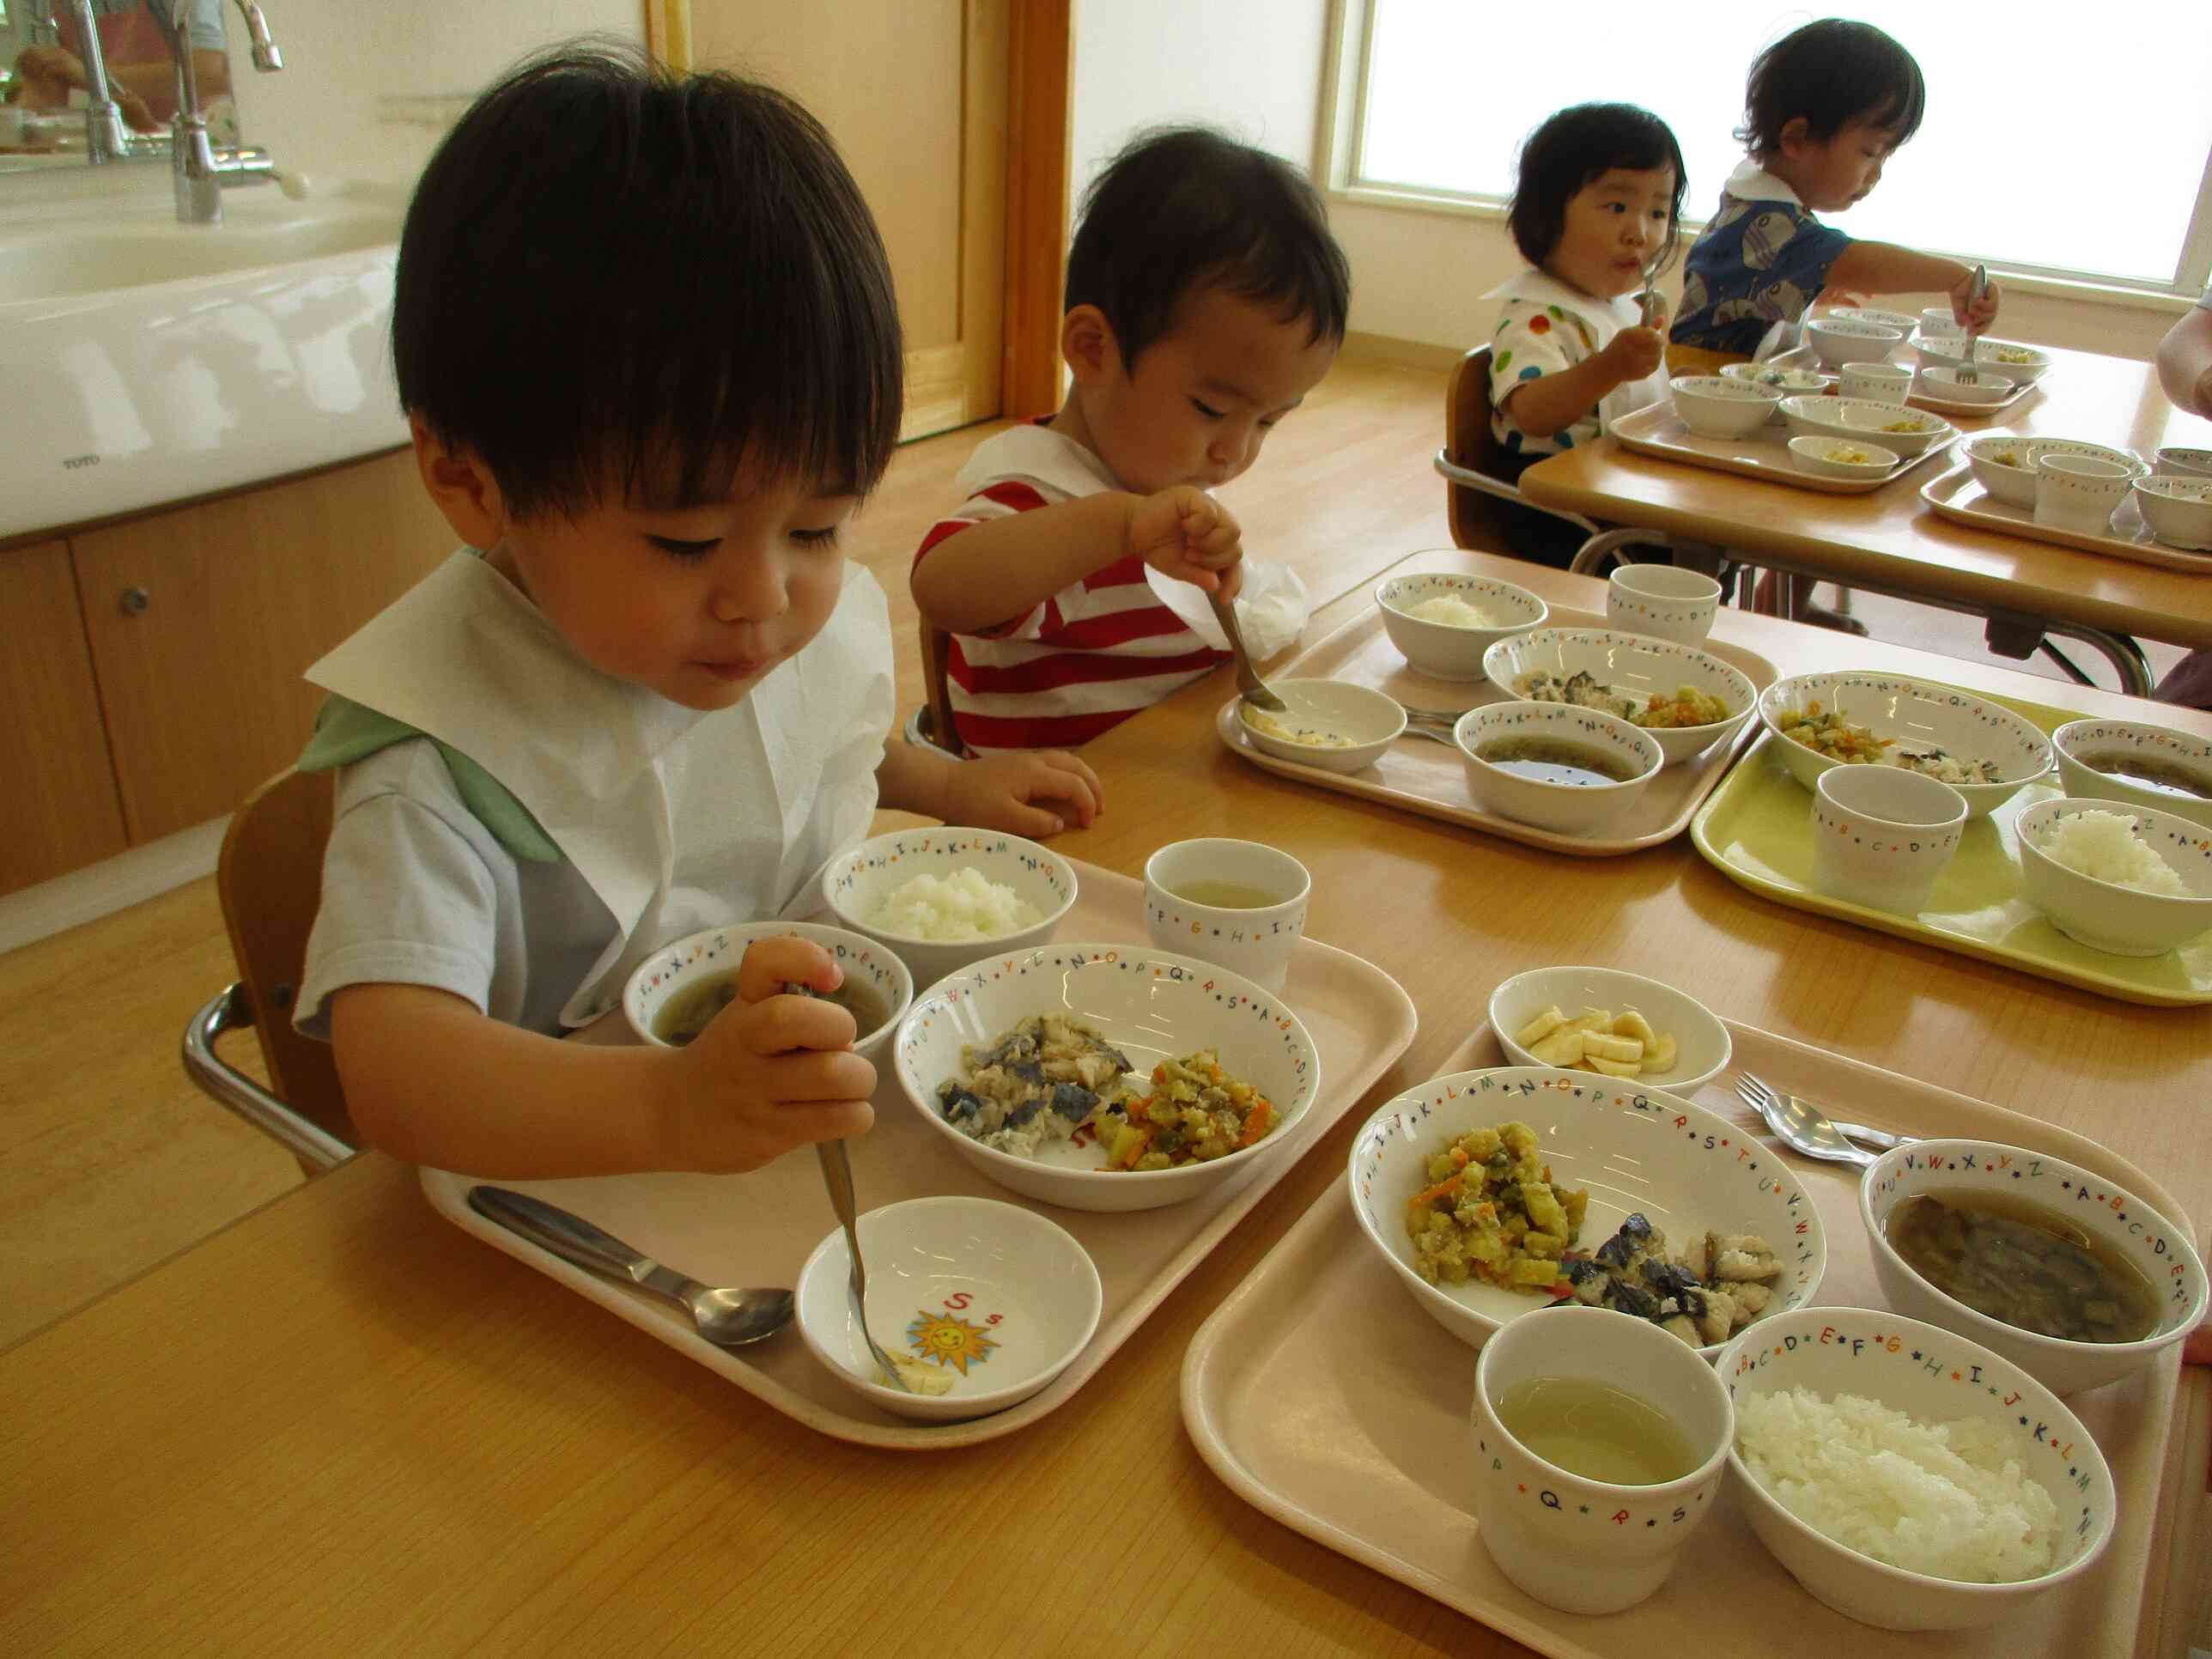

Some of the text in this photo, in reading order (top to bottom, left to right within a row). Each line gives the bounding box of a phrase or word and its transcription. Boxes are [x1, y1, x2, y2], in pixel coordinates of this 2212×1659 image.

[63, 453, 100, 470] TOTO
[1949, 696, 1960, 707] Q
[1585, 722, 1596, 732] N
[2096, 728, 2104, 738] D
[2117, 728, 2125, 738] E
[2136, 736, 2144, 746] F
[2203, 747, 2211, 757] I
[2145, 818, 2154, 830] Z
[2178, 836, 2187, 846] A
[2198, 841, 2209, 851] B
[1872, 842, 1883, 852] C
[1910, 842, 1920, 852] D
[921, 840, 932, 853] J
[948, 843, 958, 855] K
[996, 842, 1008, 853] M
[1026, 858, 1037, 872] N
[1044, 864, 1054, 877] O
[1191, 921, 1202, 933] G
[1231, 929, 1244, 942] H
[1271, 921, 1279, 933] I
[671, 957, 684, 973] X
[836, 945, 846, 957] D
[973, 972, 987, 988] X
[1003, 961, 1015, 972] Y
[1031, 954, 1043, 968] Z
[1071, 954, 1086, 969] N
[1105, 951, 1117, 963] O
[1134, 963, 1146, 974] P
[1170, 966, 1183, 981] Q
[1203, 980, 1214, 994] R
[1228, 996, 1237, 1009] S
[1259, 1008, 1268, 1022] A
[1279, 1019, 1291, 1030] B
[1287, 1043, 1297, 1054] C
[1296, 1061, 1306, 1073] D
[1480, 1075, 1496, 1091] M
[1519, 1079, 1536, 1096] N
[1558, 1078, 1571, 1091] O
[1446, 1085, 1457, 1100] L
[1592, 1091, 1604, 1103] P
[1419, 1102, 1431, 1118] K
[1632, 1095, 1649, 1110] Q
[1674, 1115, 1687, 1129] R
[1704, 1136, 1715, 1150] S
[1737, 1148, 1750, 1161] T
[1759, 1180, 1771, 1190] U
[1787, 1193, 1801, 1206] V
[1905, 1154, 1914, 1170] V
[1928, 1155, 1944, 1170] W
[1961, 1153, 1976, 1170] X
[1999, 1152, 2013, 1169] Y
[2027, 1161, 2044, 1177] Z
[2076, 1187, 2089, 1200] A
[2110, 1196, 2124, 1211] B
[2128, 1222, 2143, 1235] C
[2154, 1238, 2166, 1255] D
[2171, 1263, 2185, 1279] E
[1795, 1219, 1808, 1234] W
[1797, 1250, 1814, 1263] X
[943, 1291, 974, 1310] S
[1759, 1349, 1769, 1367] C
[1784, 1334, 1797, 1351] D
[1820, 1327, 1836, 1344] E
[1851, 1339, 1864, 1357] F
[1886, 1335, 1903, 1353] G
[1923, 1357, 1944, 1376] H
[1969, 1364, 1983, 1383] I
[2004, 1391, 2022, 1407] J
[2033, 1422, 2047, 1442] K
[2061, 1443, 2074, 1461] L
[2075, 1472, 2091, 1492] M
[1540, 1491, 1562, 1510] Q
[1611, 1509, 1629, 1525] R
[1672, 1506, 1686, 1523] S
